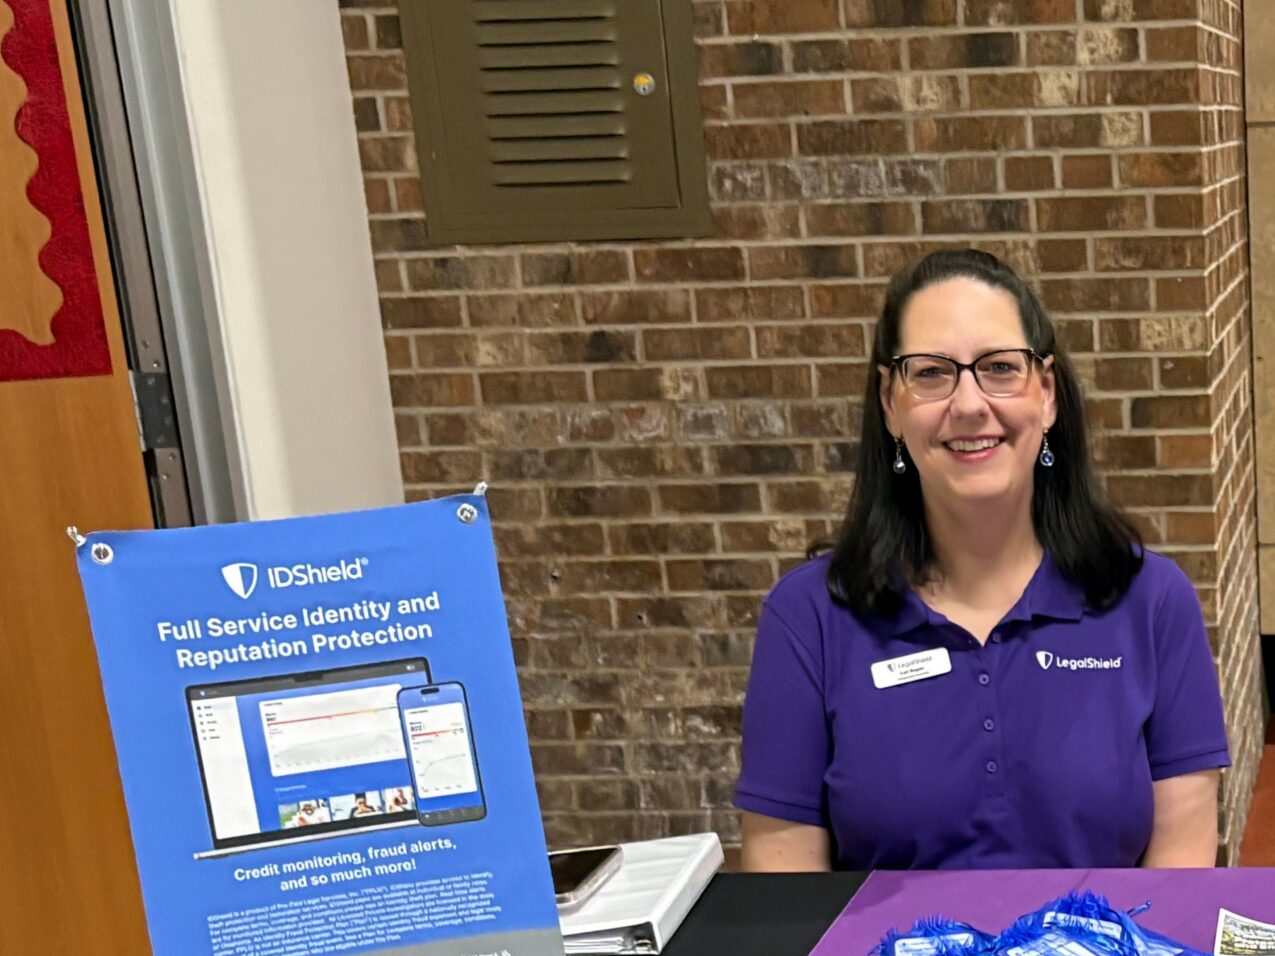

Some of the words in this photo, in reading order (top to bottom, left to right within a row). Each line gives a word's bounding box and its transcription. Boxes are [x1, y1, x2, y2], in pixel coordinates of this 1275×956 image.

[157, 619, 201, 641] Full
[207, 612, 297, 637] Service
[303, 601, 391, 627] Identity
[397, 592, 440, 615] and
[176, 639, 307, 670] Reputation
[312, 623, 432, 653] Protection
[234, 864, 280, 881] Credit
[282, 851, 366, 875] monitoring,
[367, 843, 408, 859] fraud
[410, 838, 457, 854] alerts,
[280, 876, 307, 891] and
[310, 873, 329, 886] so
[331, 867, 372, 883] much
[374, 858, 416, 876] more!
